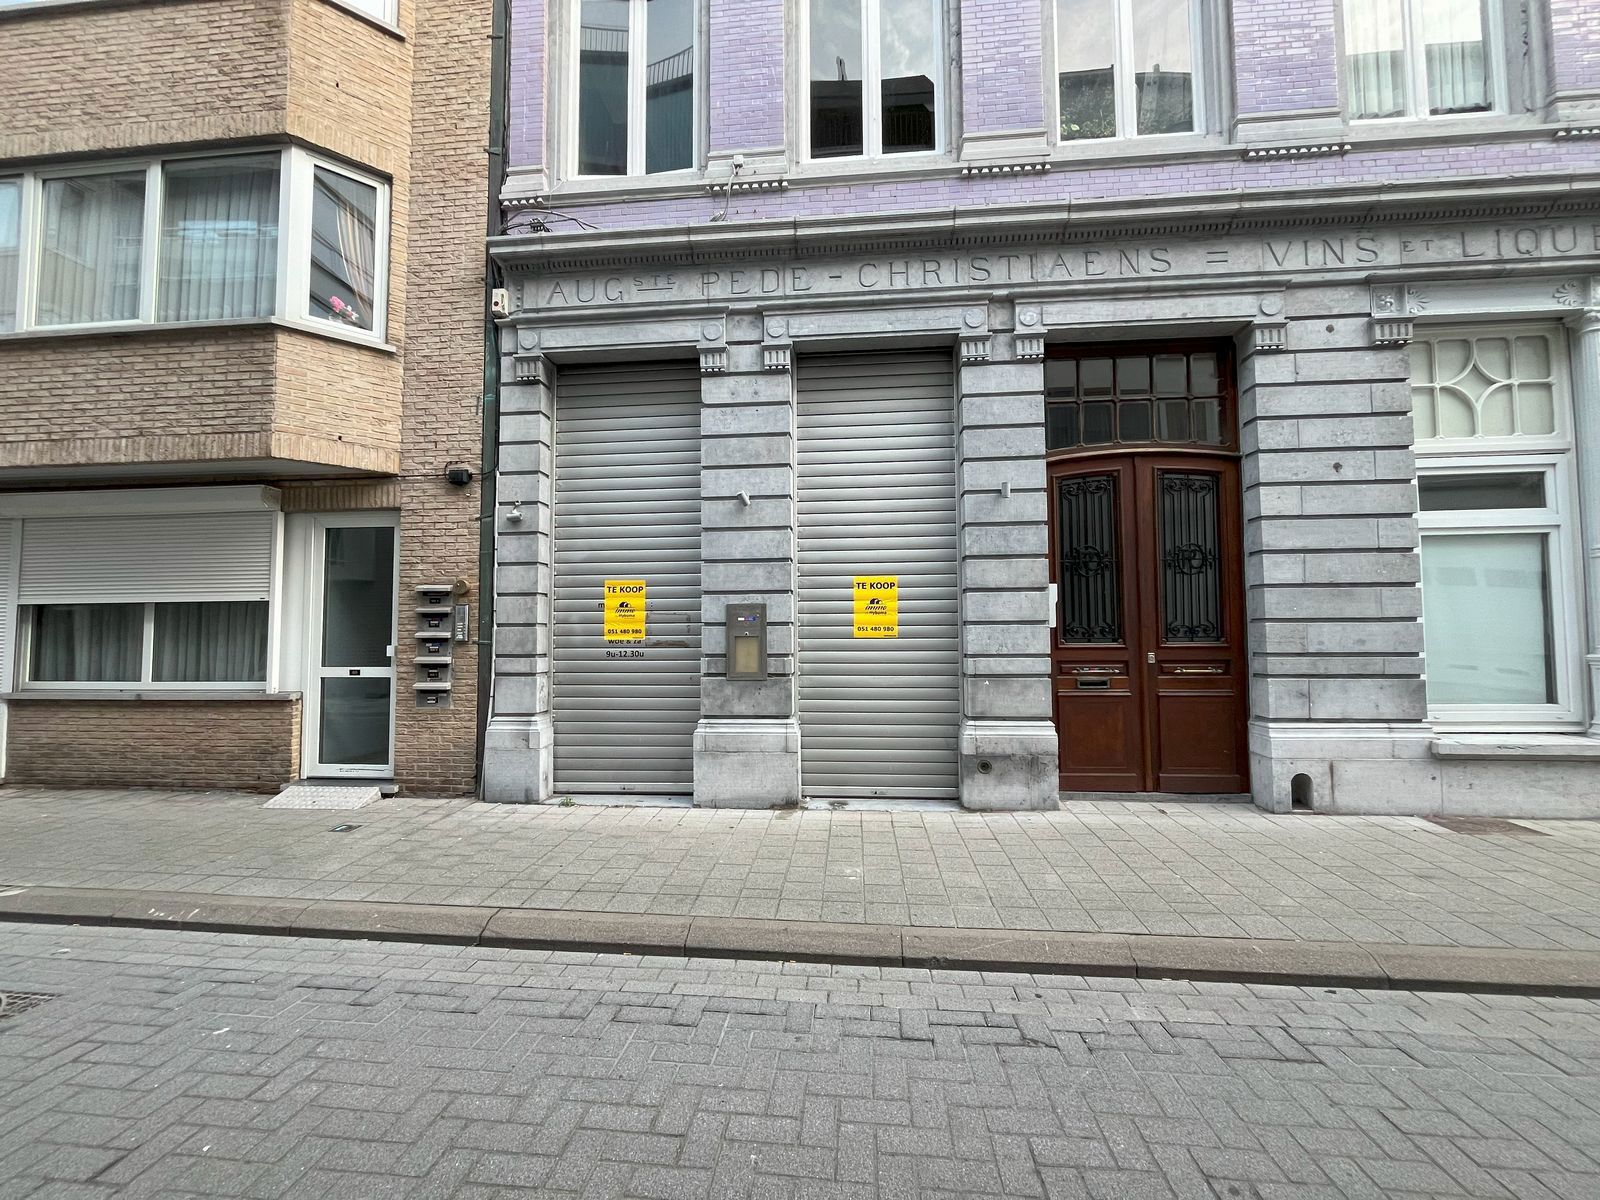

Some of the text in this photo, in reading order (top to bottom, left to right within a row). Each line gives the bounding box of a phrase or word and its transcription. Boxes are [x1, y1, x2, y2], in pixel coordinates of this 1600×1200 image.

[701, 267, 812, 296] PEDE
[858, 248, 1172, 288] CHRISTIAENS
[1265, 237, 1379, 268] VINS
[1403, 239, 1434, 253] ET
[856, 582, 896, 590] TE KOOP
[605, 650, 645, 658] 9u-12.30u
